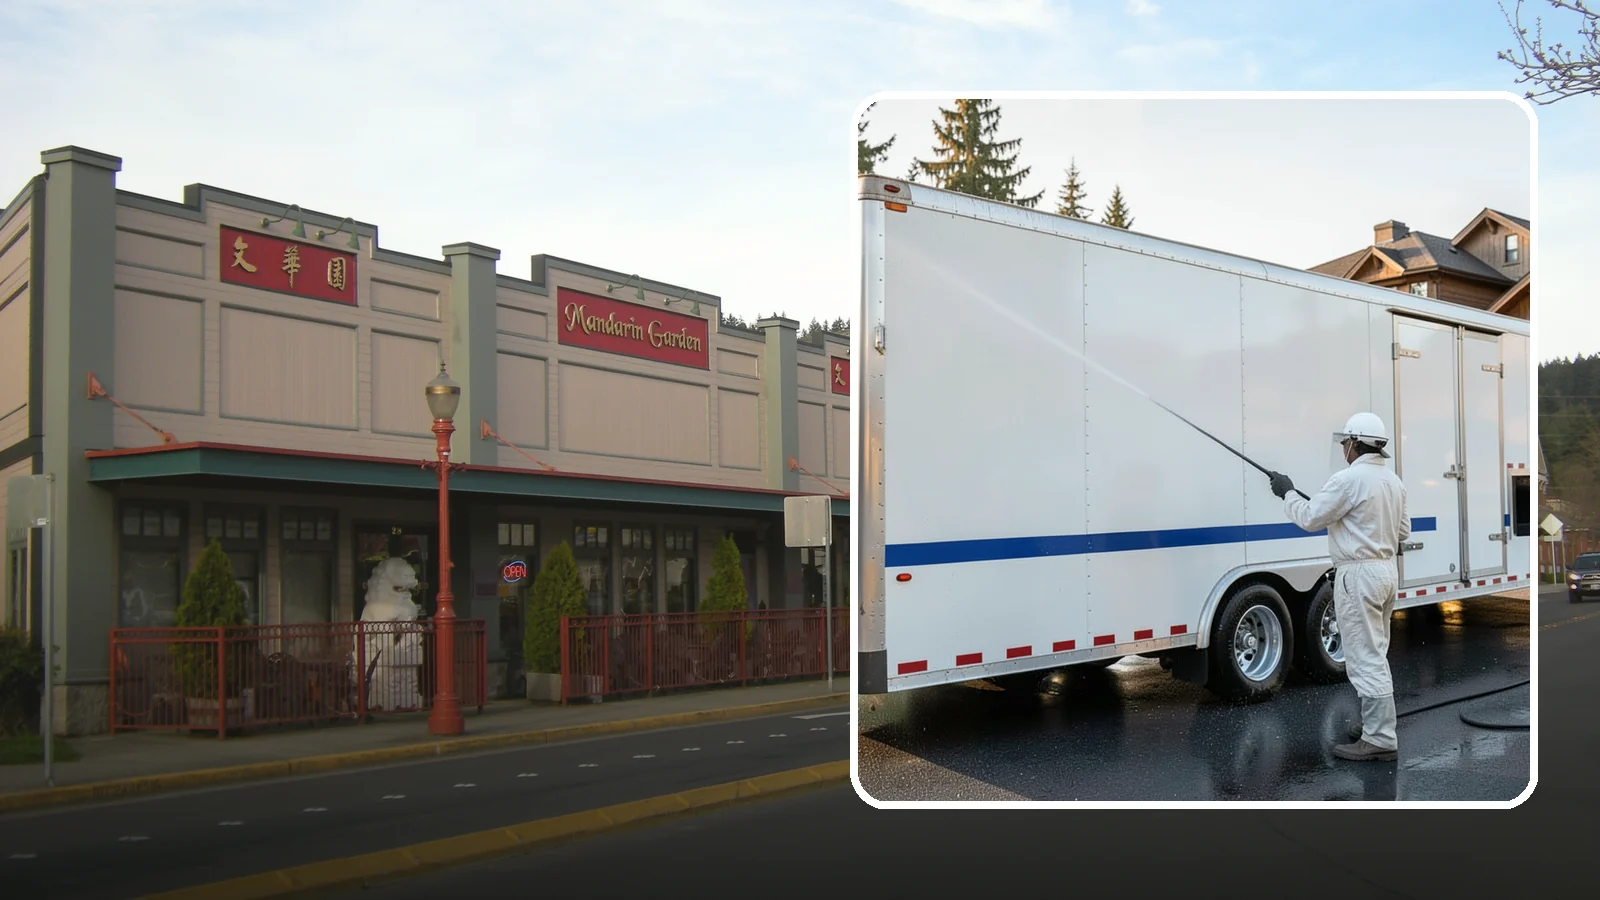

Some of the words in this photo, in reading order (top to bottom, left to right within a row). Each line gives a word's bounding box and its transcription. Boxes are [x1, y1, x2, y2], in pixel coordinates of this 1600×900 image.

[231, 235, 346, 291] 文華園
[565, 302, 643, 339] Mandarin
[648, 320, 702, 352] Garden
[503, 565, 526, 578] OPEN
